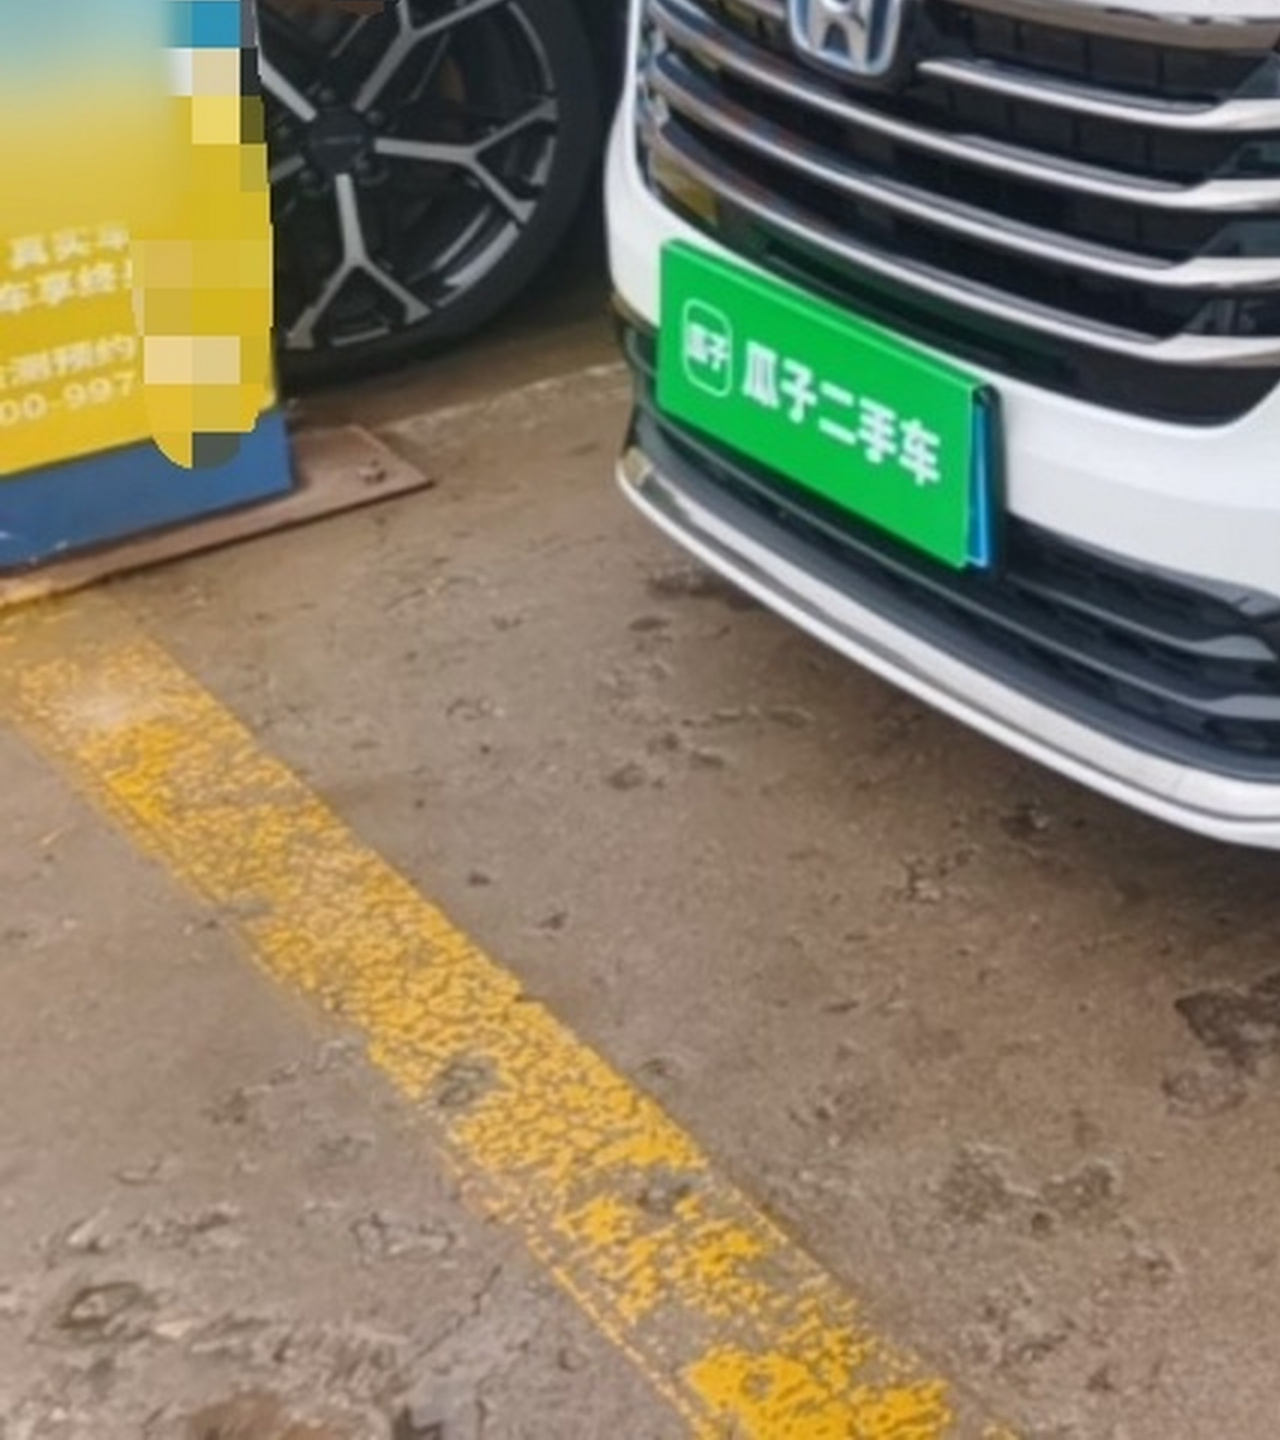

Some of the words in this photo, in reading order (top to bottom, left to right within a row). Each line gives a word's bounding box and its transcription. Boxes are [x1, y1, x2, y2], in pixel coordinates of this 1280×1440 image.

[742, 340, 942, 488] 瓜子二手车
